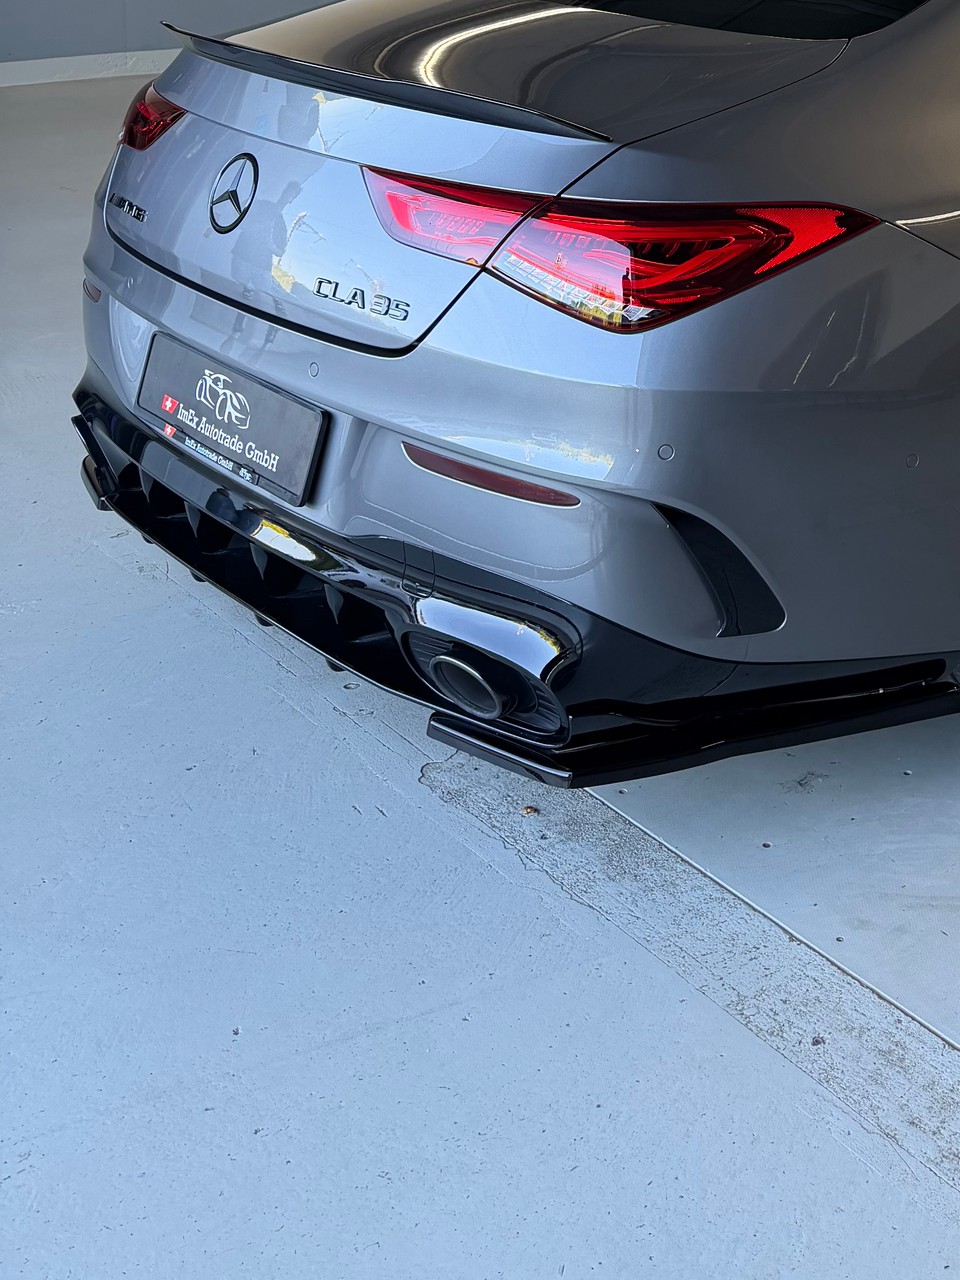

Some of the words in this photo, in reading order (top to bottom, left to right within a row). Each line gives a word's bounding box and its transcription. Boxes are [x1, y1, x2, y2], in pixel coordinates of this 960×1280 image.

[313, 277, 365, 310] CLA
[369, 294, 411, 322] 35
[177, 403, 199, 429] ImEx
[197, 416, 243, 454] Autotrade
[245, 442, 279, 472] GmbH
[217, 455, 234, 471] GmbH
